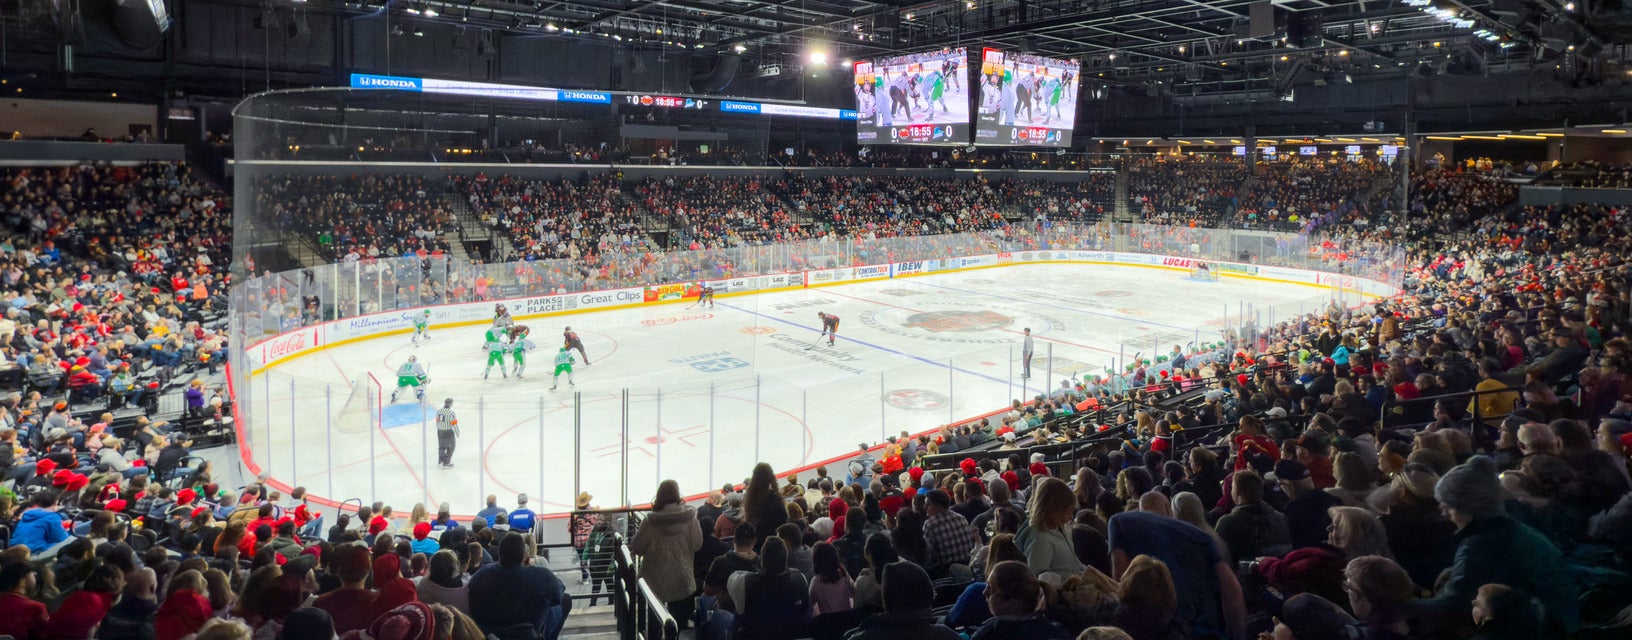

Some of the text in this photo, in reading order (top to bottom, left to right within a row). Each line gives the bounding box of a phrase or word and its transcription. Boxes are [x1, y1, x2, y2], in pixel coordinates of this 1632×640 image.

[371, 78, 416, 88] HONDA
[572, 92, 606, 101] HONDA
[655, 97, 675, 106] 18:55
[732, 103, 758, 112] HONDA
[891, 127, 897, 139] 0
[910, 126, 931, 137] 18:55
[945, 125, 952, 137] 0
[1011, 128, 1017, 139] 0
[1028, 128, 1046, 139] 18:55
[1056, 130, 1061, 142] 0
[898, 261, 923, 272] IBEW
[1163, 257, 1191, 268] LUCAS
[657, 284, 685, 295] RED GOLD
[527, 296, 557, 306] PARKS
[581, 290, 641, 305] Great Clips
[527, 303, 557, 313] PLACE
[350, 317, 399, 330] Millennium
[270, 333, 306, 360] Coca-Cola
